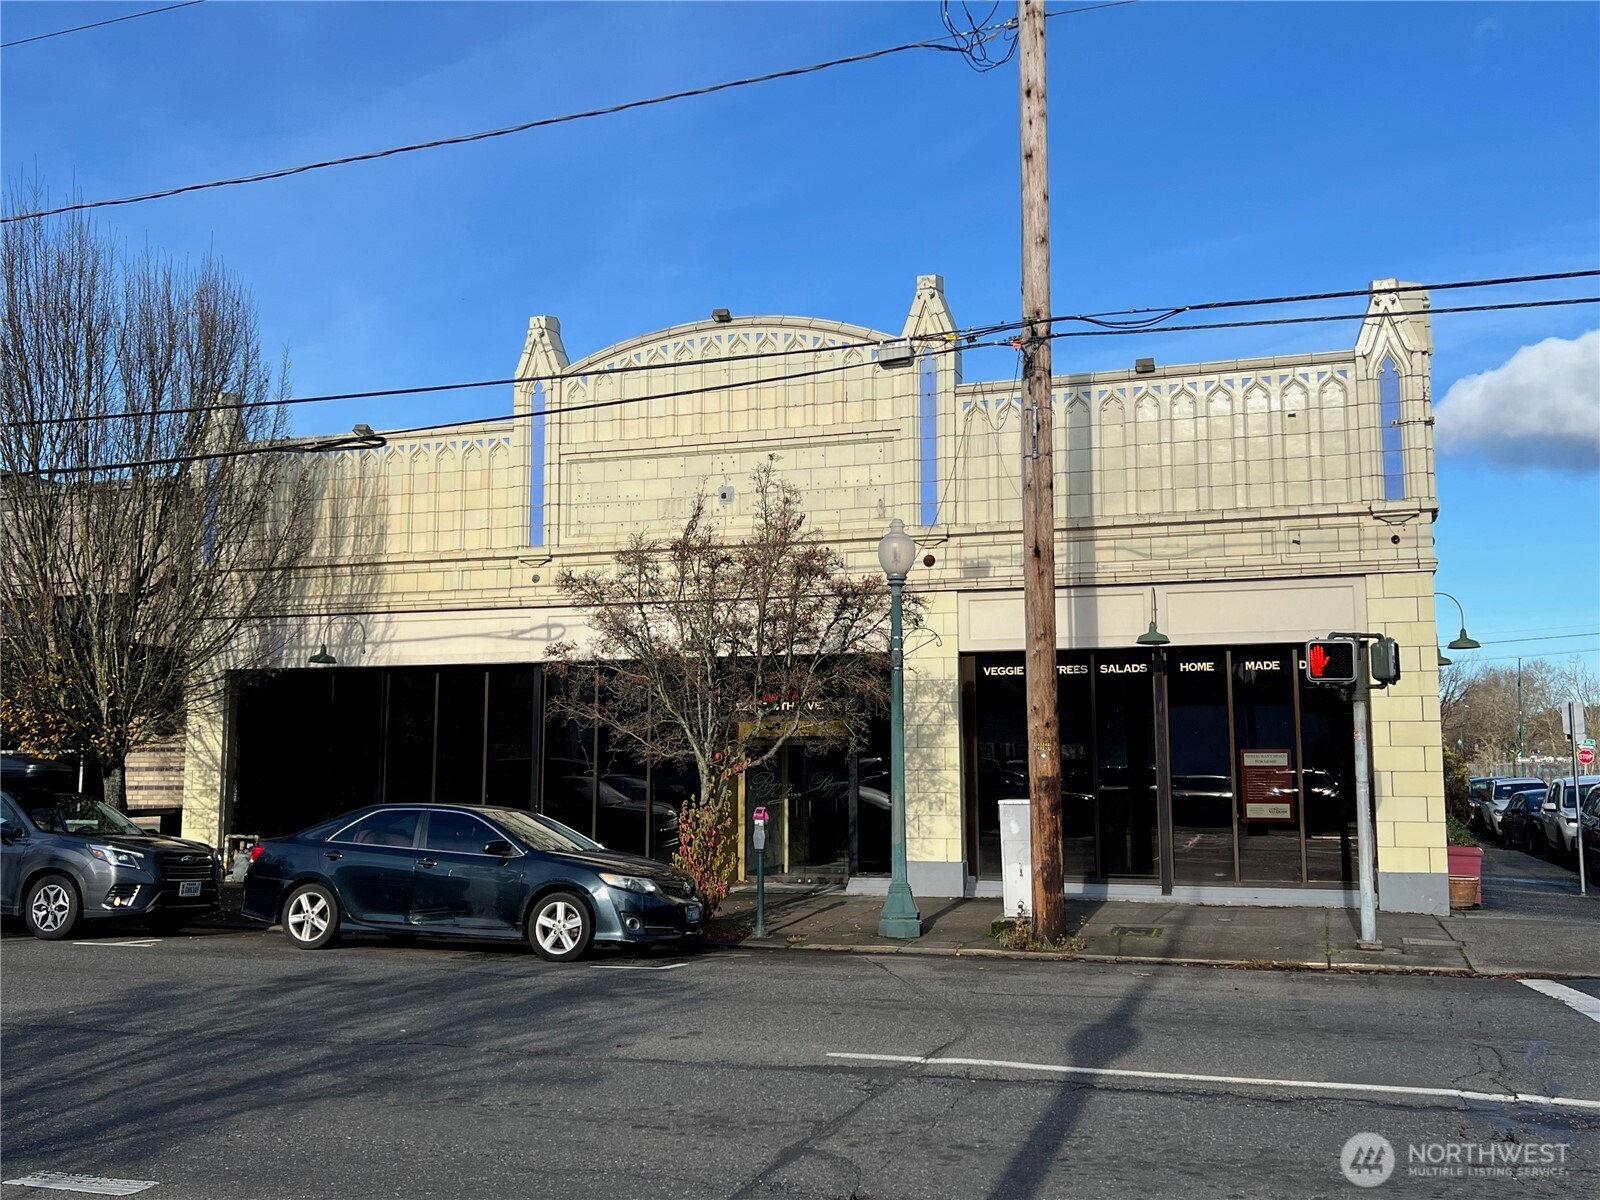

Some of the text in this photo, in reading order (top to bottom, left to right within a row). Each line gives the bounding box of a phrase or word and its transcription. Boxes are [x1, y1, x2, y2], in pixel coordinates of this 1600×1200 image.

[983, 666, 1024, 676] VEGGIE
[1100, 664, 1148, 673] SALADS
[1180, 662, 1214, 672] HOME
[1245, 661, 1280, 670] MADE
